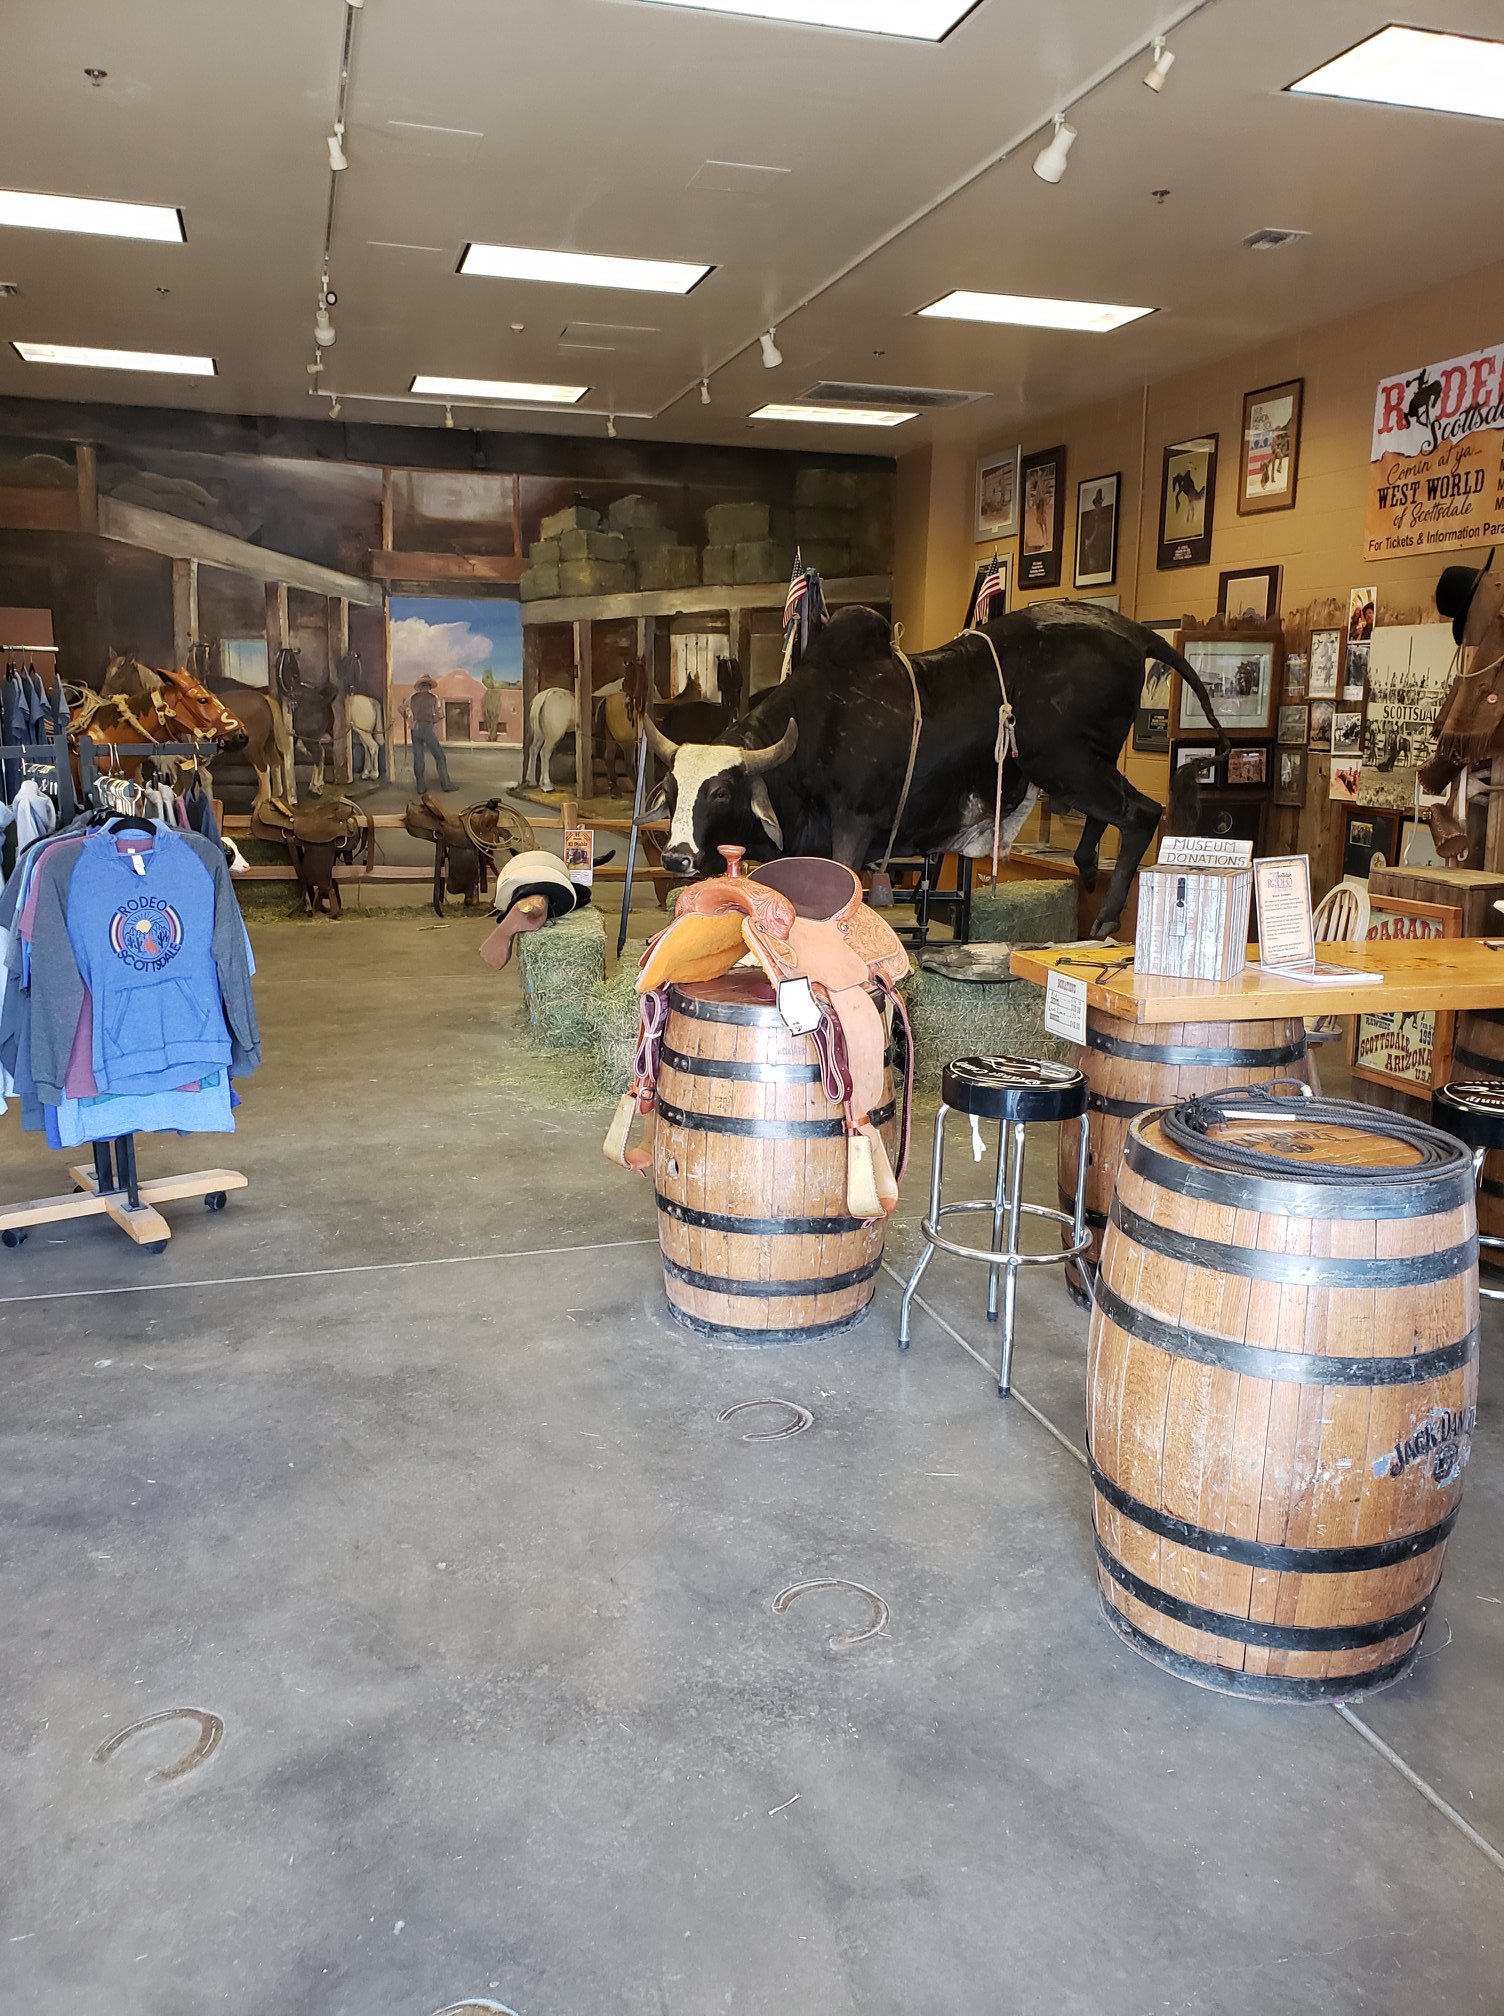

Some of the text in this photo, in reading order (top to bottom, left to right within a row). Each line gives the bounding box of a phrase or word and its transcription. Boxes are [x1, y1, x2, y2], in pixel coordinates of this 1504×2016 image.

[1378, 355, 1504, 434] RDE
[1387, 460, 1431, 486] Comin
[1438, 444, 1455, 468] at
[1377, 481, 1420, 509] WEST
[1426, 468, 1485, 501] WORLD
[1393, 494, 1473, 529] of Scottsdale
[1369, 538, 1383, 552] For
[1386, 533, 1414, 550] Tickets
[1417, 531, 1424, 545] &
[1427, 523, 1480, 545] Information
[1167, 852, 1246, 867] DONATIONS
[1173, 839, 1236, 853] MUSEUM
[117, 896, 167, 917] RODEO
[117, 943, 181, 972] SCOTTSDALE
[1360, 1032, 1410, 1058] SCOTTSDALE
[1419, 1028, 1433, 1045] 199
[1385, 1048, 1432, 1072] ARIZONA
[1389, 1422, 1438, 1478] JACK
